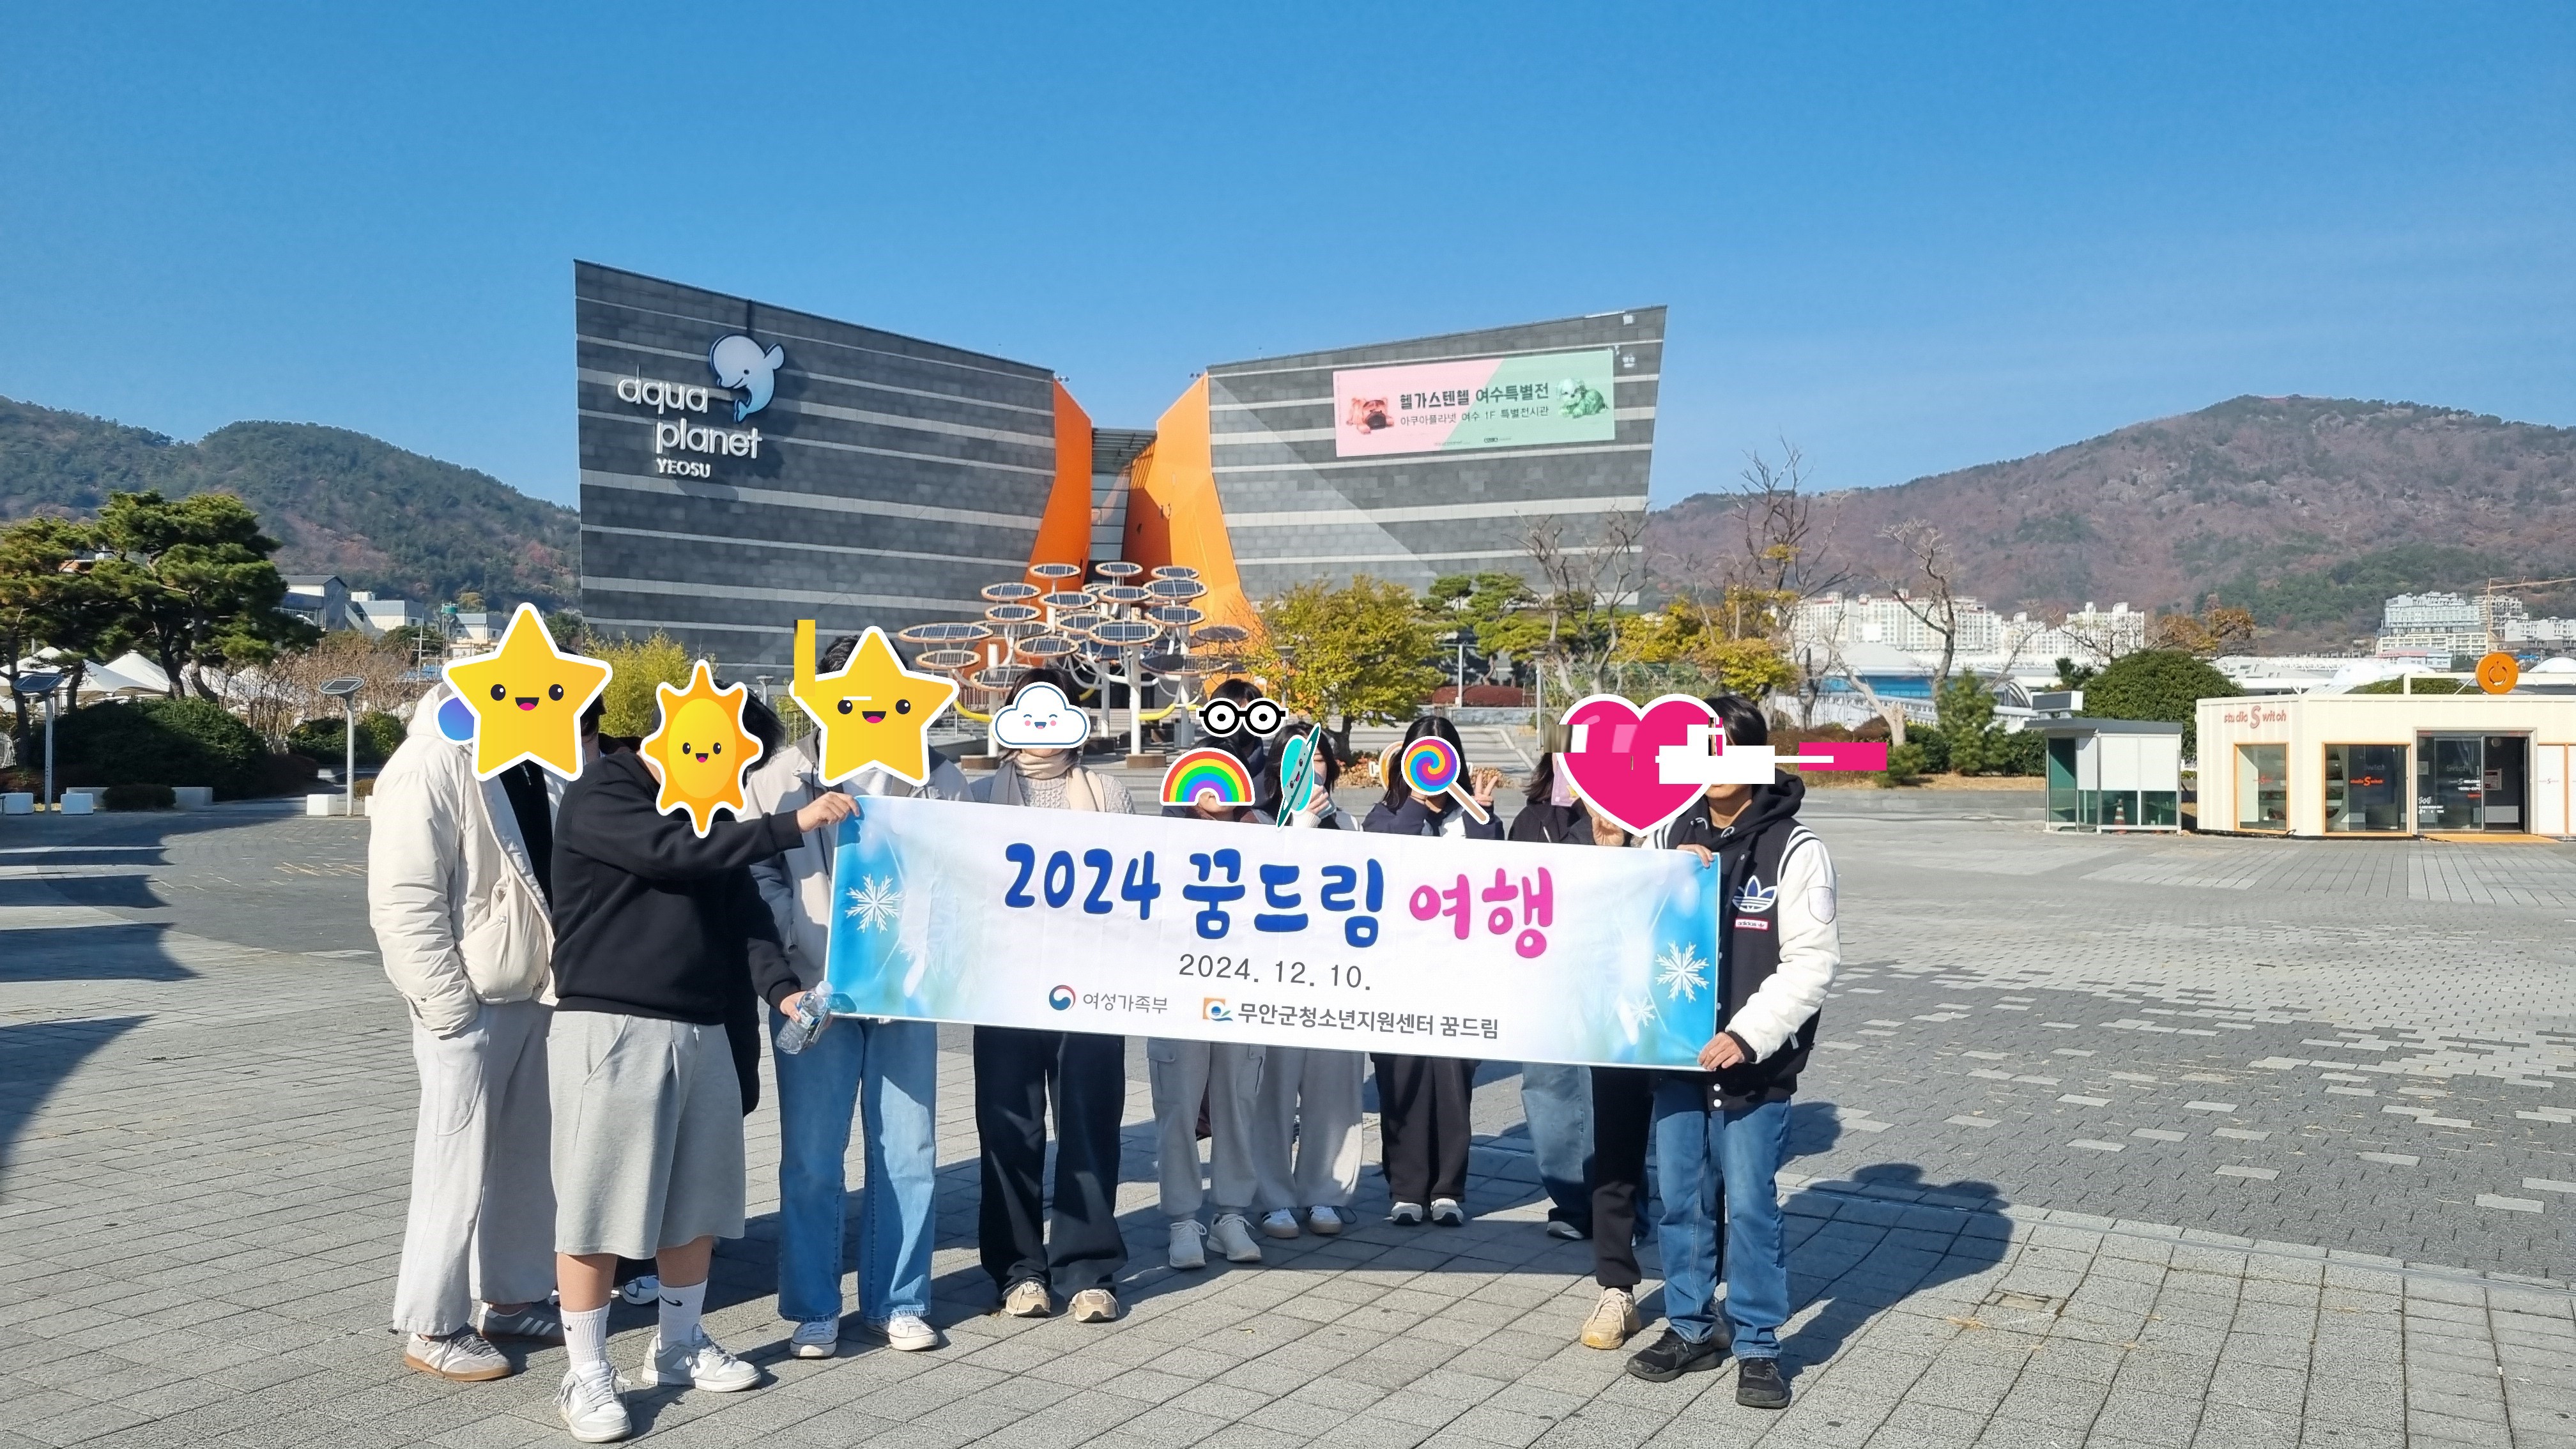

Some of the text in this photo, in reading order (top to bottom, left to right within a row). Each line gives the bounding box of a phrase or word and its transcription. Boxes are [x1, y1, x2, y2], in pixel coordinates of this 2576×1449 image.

[617, 378, 709, 414] aqua
[1475, 382, 1549, 404] 여수특별전
[1400, 413, 1456, 426] 아쿠아플라넷
[1461, 411, 1480, 422] 여수
[656, 417, 763, 459] planet
[656, 458, 710, 478] YEOSU
[1005, 843, 1554, 958] 2024 꿈드림 여행
[1179, 953, 1370, 990] 2024. 12. 10.
[1083, 992, 1168, 1014] 여성가족부
[1238, 1003, 1498, 1039] 무안군청소년지원센터 꿈드림
